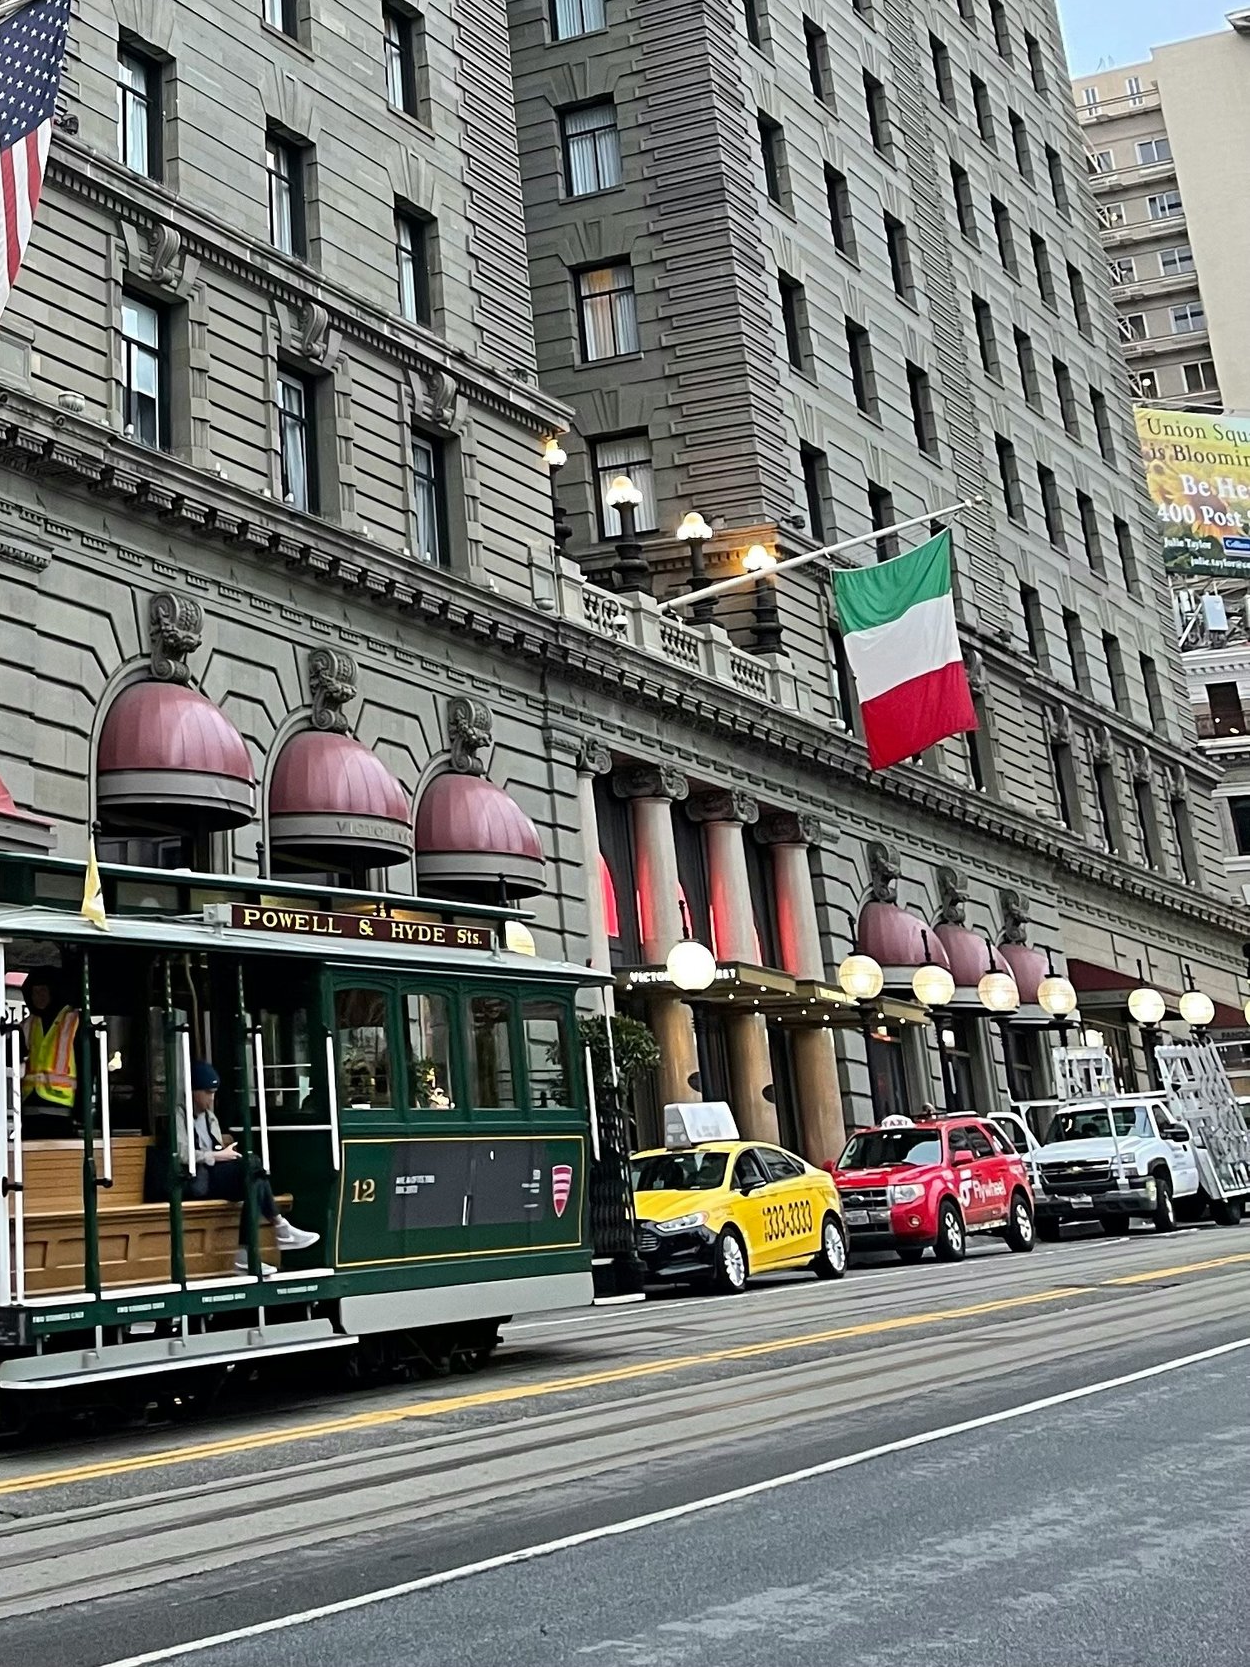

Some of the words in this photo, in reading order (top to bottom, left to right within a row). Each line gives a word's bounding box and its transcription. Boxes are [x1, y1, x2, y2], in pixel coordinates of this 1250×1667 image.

[1147, 417, 1207, 439] Union
[1213, 423, 1250, 447] Squ
[1151, 443, 1166, 460] is
[1180, 474, 1211, 496] Be
[1215, 476, 1250, 500] He
[1157, 502, 1196, 524] 400
[1200, 505, 1244, 527] Post
[243, 908, 342, 934] POWELL
[358, 919, 374, 936] &
[391, 922, 446, 943] HYDE
[457, 929, 483, 945] Sts.
[883, 1119, 908, 1128] TAXI
[352, 1178, 376, 1203] 12
[973, 1177, 1007, 1203] Flywheel
